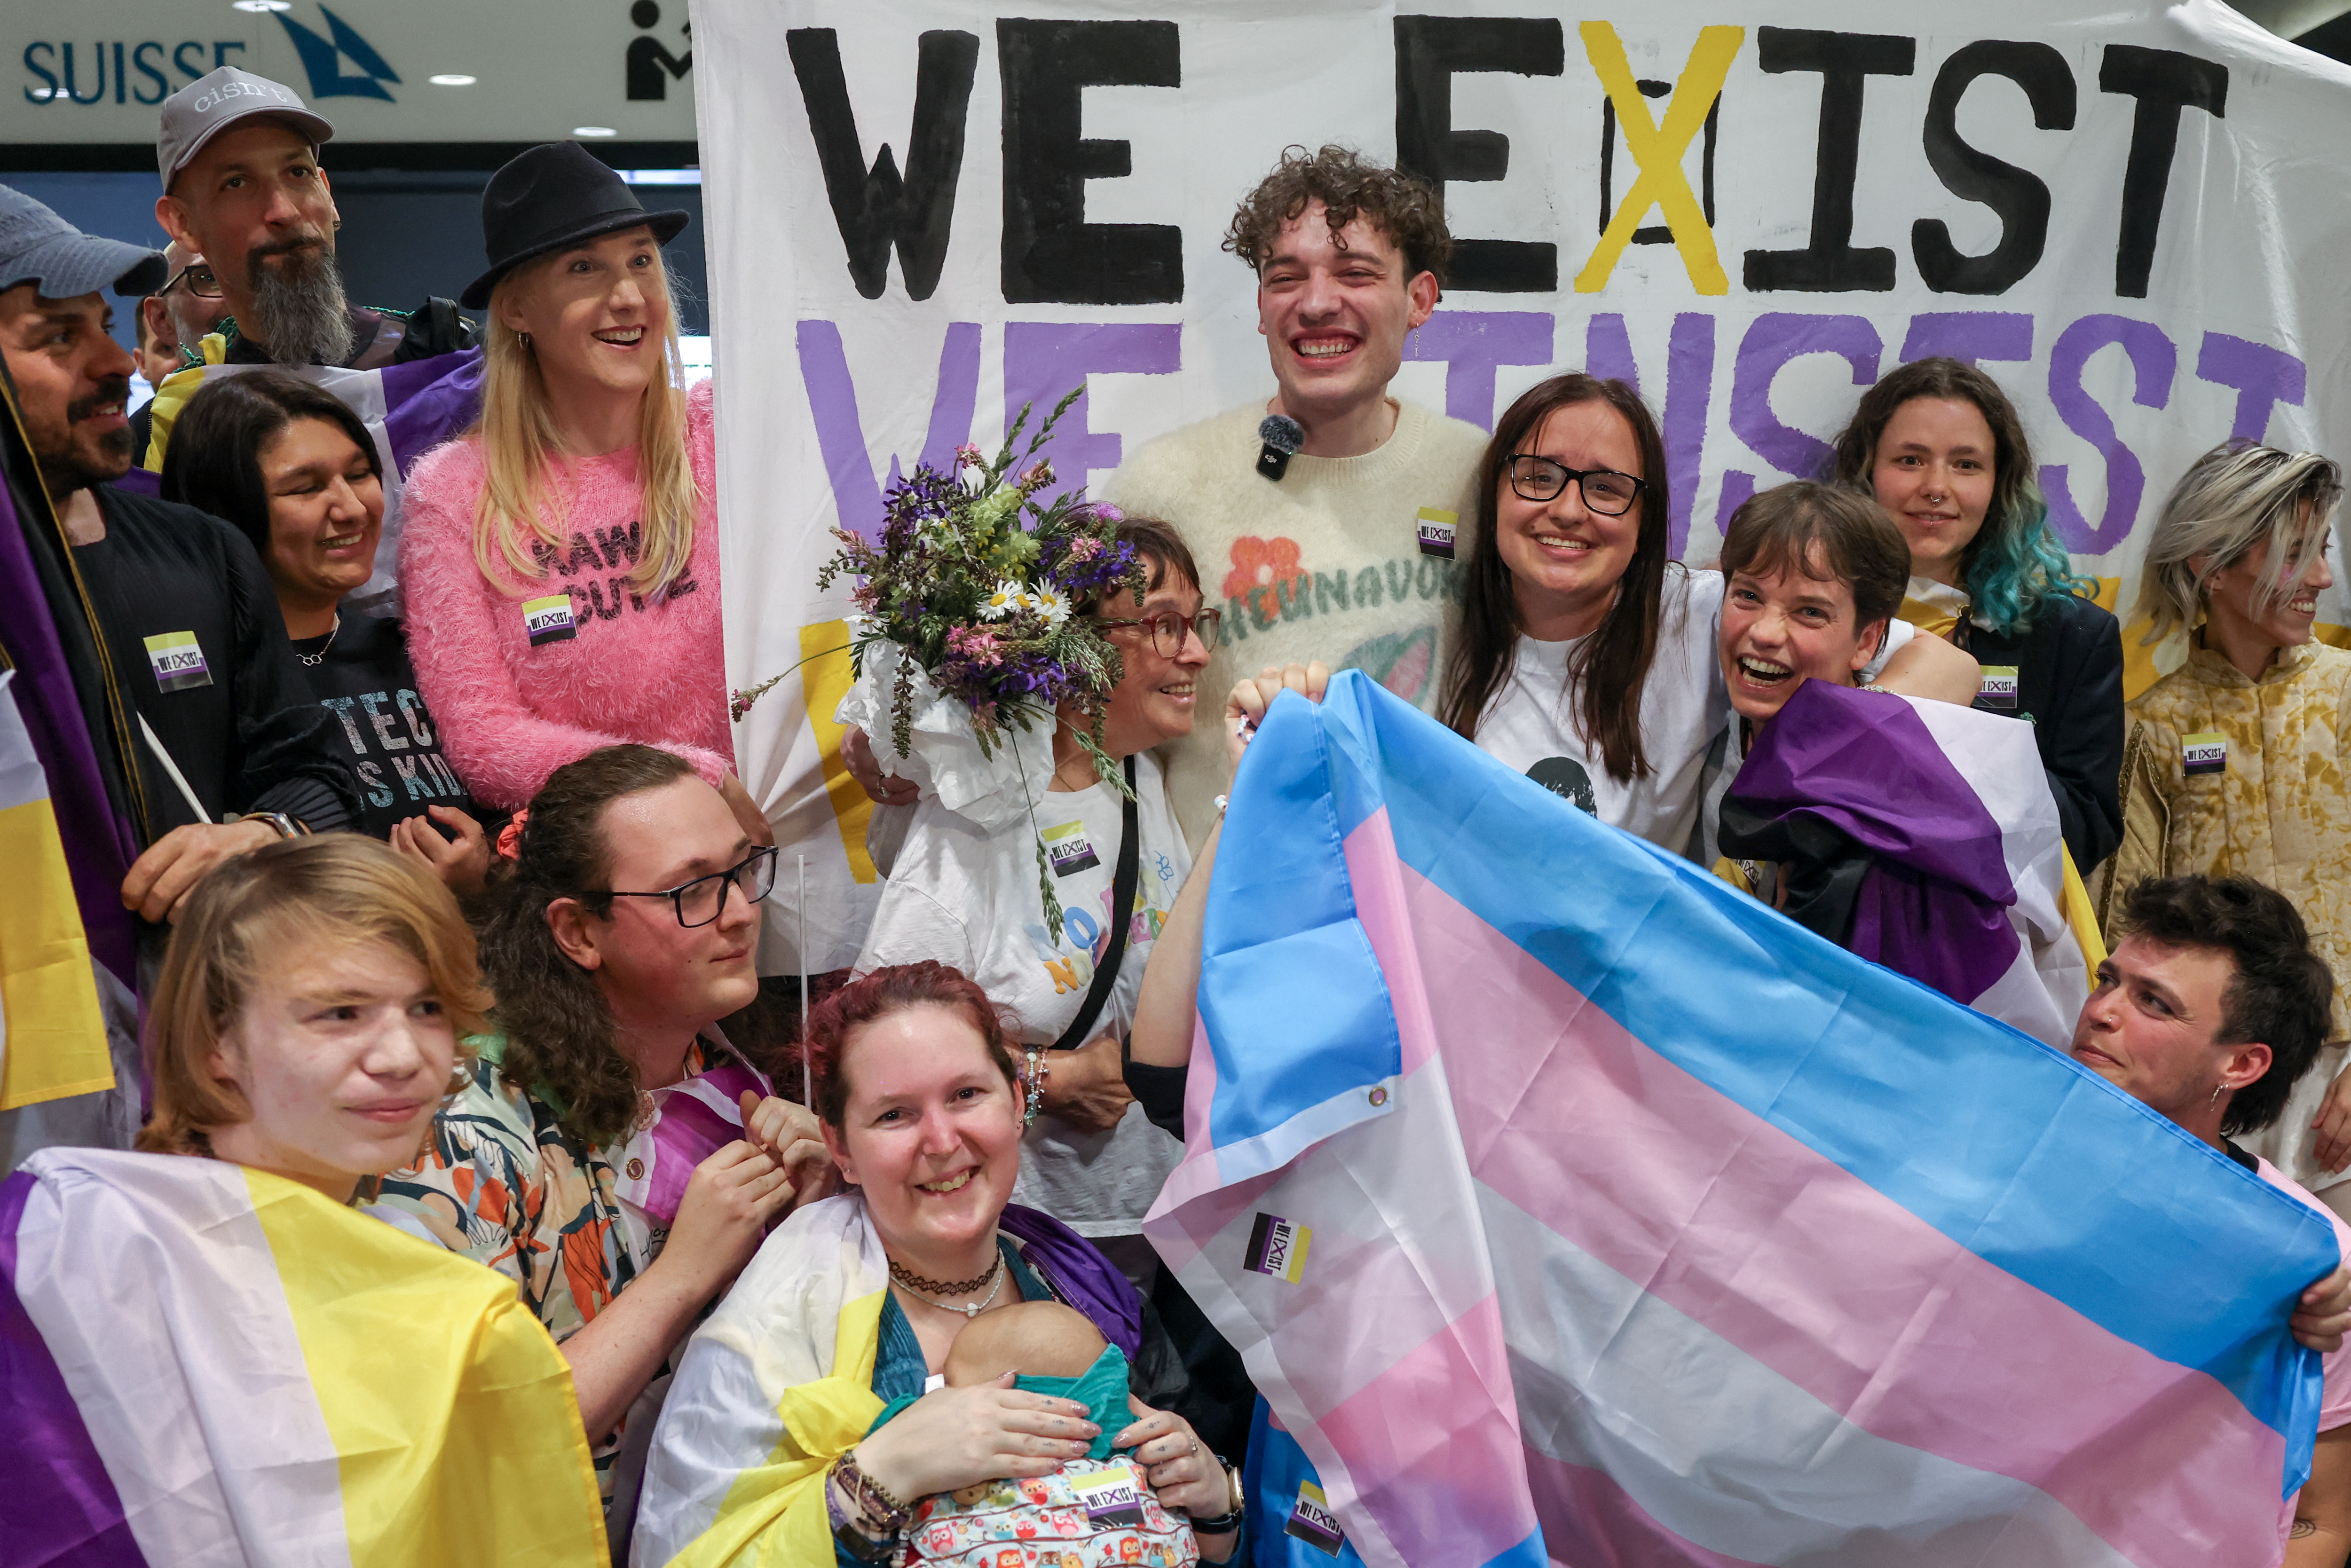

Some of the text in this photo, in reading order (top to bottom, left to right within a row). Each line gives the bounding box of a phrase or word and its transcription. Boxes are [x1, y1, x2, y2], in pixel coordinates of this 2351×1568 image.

[194, 81, 288, 113] cisn't
[787, 14, 2228, 304] WE EXIST
[1421, 525, 1451, 542] WE EXIST
[530, 612, 568, 630] WE EXIST
[158, 652, 199, 671] WE EXIST
[1988, 681, 2012, 692] EXIST
[2188, 748, 2222, 760] WE EXIST
[1051, 839, 1087, 859] WE EXIST
[1267, 1223, 1291, 1271] WE EXIST
[1086, 1487, 1134, 1508] WE EXIST
[1299, 1500, 1313, 1518] WE
